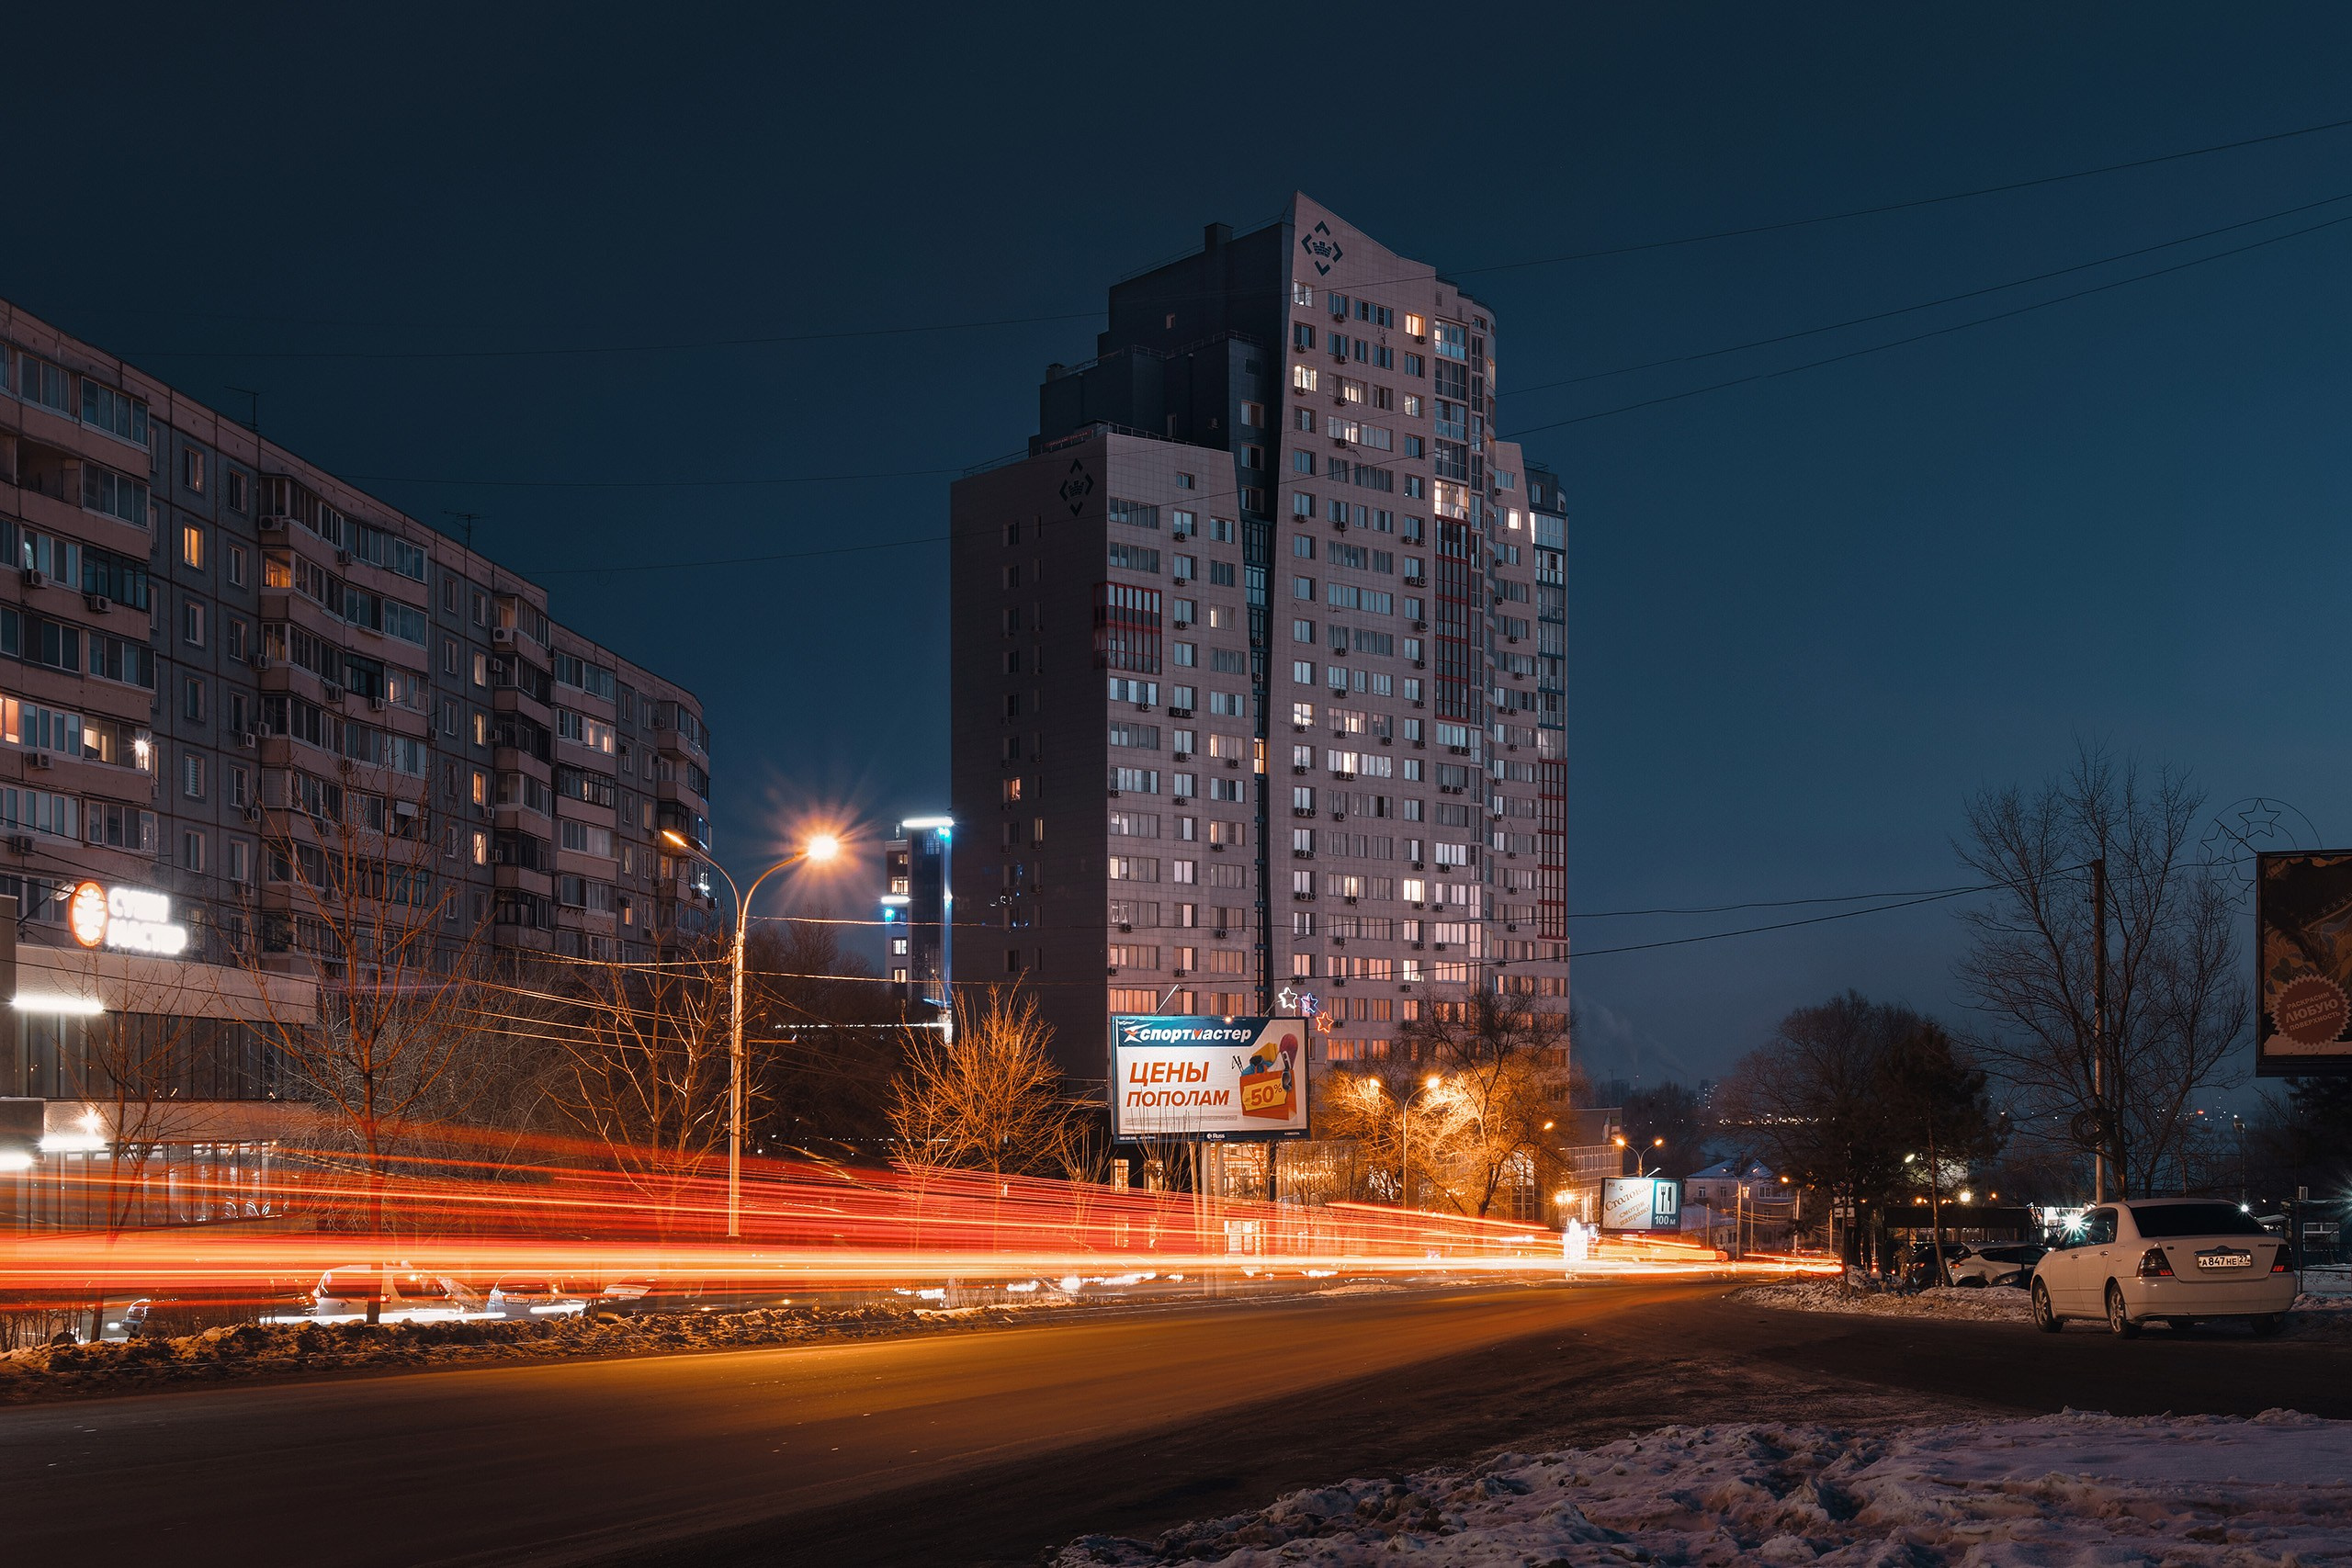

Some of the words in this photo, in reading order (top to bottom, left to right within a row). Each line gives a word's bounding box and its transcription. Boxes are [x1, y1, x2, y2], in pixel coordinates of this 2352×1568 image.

[2287, 991, 2330, 1010] РАСКРАСИМ
[2286, 998, 2338, 1023] ЛЮБУЮ
[2290, 1011, 2341, 1031] ПОВЕРХНОСТЬ
[1129, 1061, 1210, 1087] ЦЕНЫ
[1126, 1089, 1230, 1107] ПОПОЛАМ
[1655, 1215, 1669, 1224] 100
